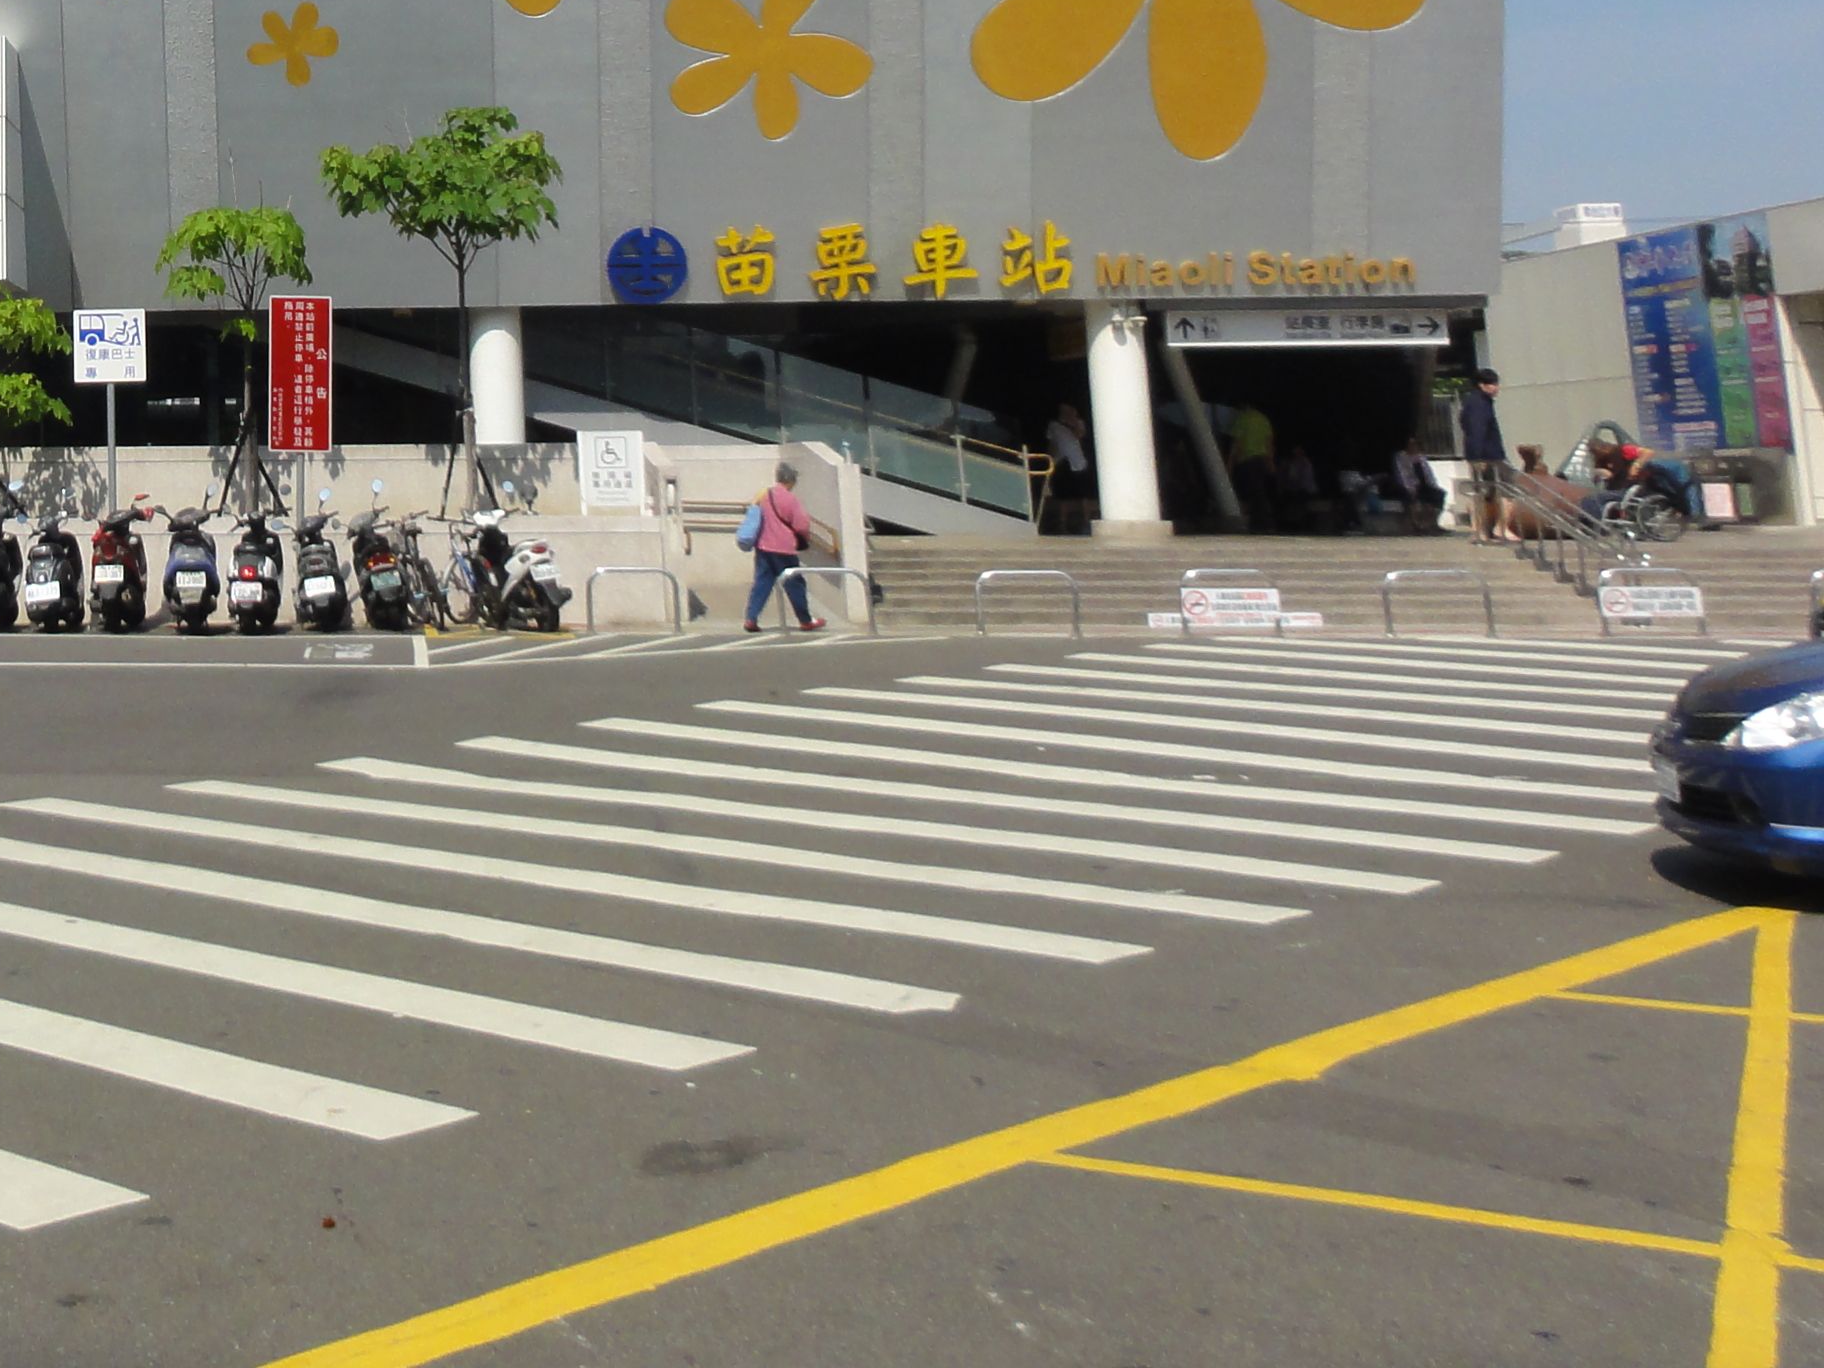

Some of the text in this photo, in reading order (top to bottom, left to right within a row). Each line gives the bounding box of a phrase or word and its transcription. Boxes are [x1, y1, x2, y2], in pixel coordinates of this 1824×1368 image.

[714, 220, 1074, 300] 苗栗車站
[1096, 250, 1417, 287] Miaoli Station
[85, 366, 136, 379] 專用
[86, 348, 136, 360] 復康巴士
[316, 348, 327, 399] 公告
